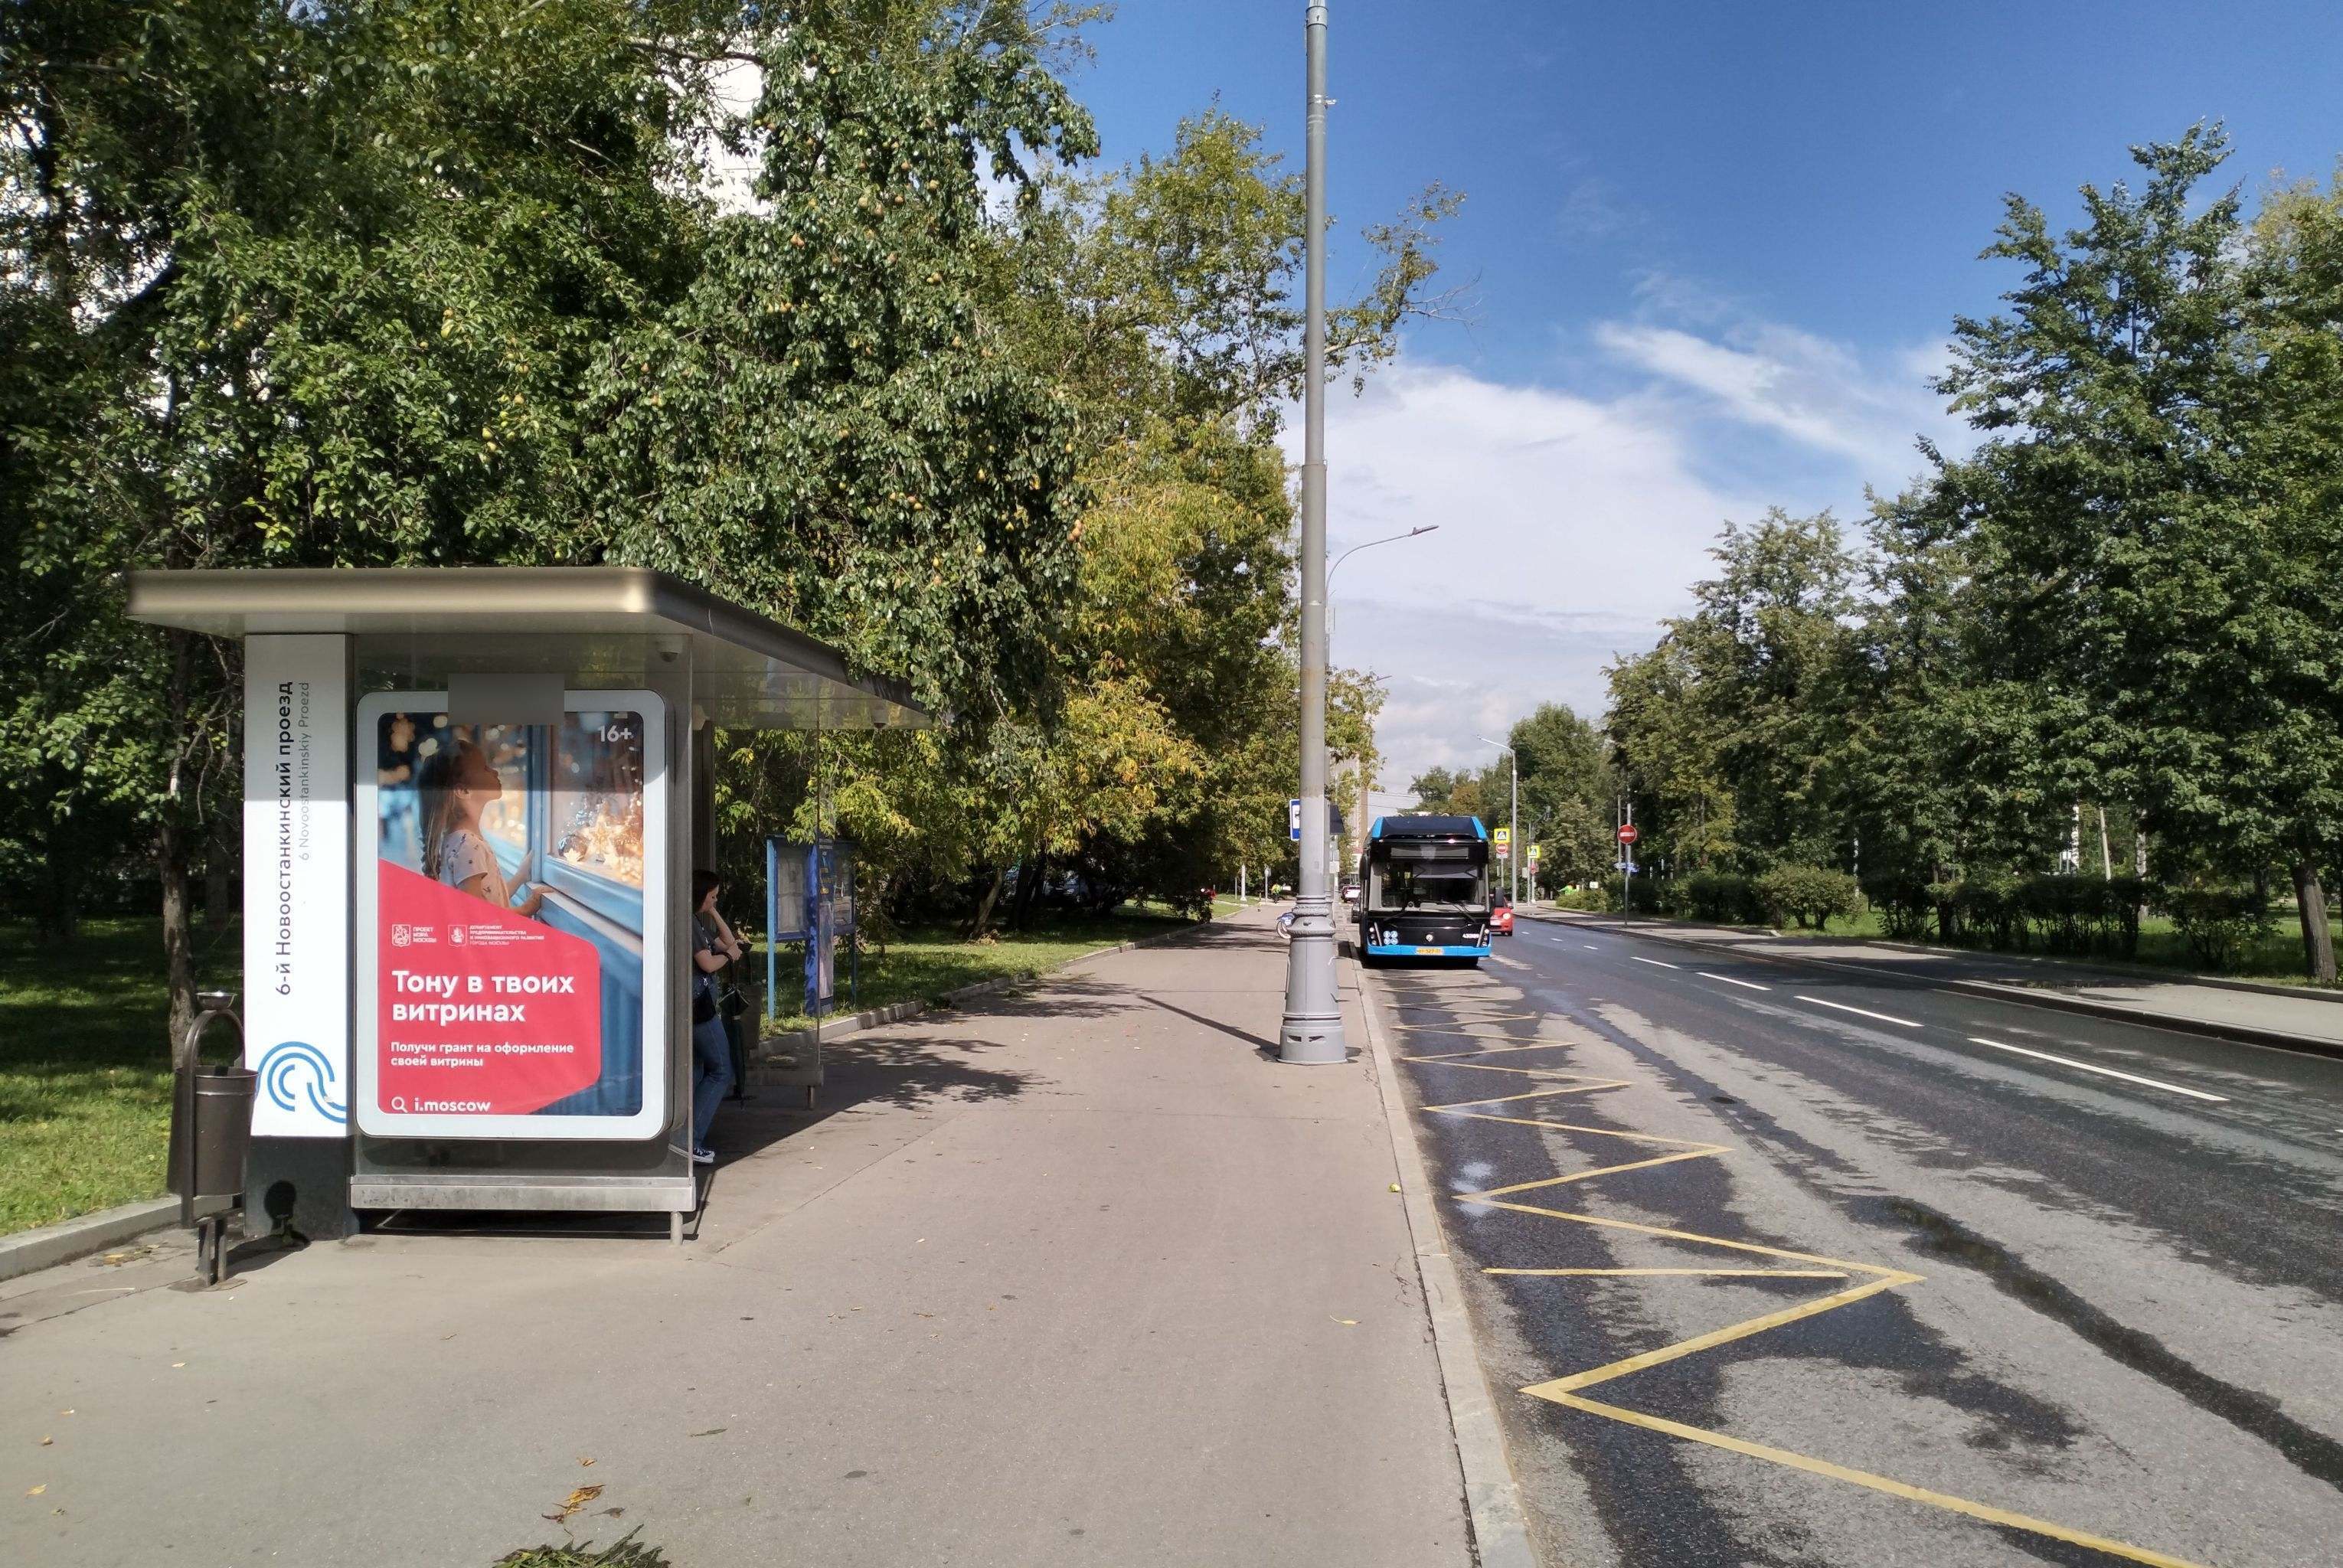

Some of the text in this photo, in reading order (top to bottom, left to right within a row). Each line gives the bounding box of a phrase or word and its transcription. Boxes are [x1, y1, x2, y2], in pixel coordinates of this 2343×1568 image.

[597, 725, 632, 742] 16+
[298, 681, 312, 861] 6 Novoostankinskiy Proezd
[275, 681, 294, 996] 6-й Новоостанкинский проезд
[391, 970, 575, 998] Тону в твоих
[392, 1004, 526, 1027] витринах
[390, 1041, 574, 1055] Получи грант на оформление
[390, 1054, 484, 1069] своей витрины
[414, 1097, 492, 1112] i.moscow
